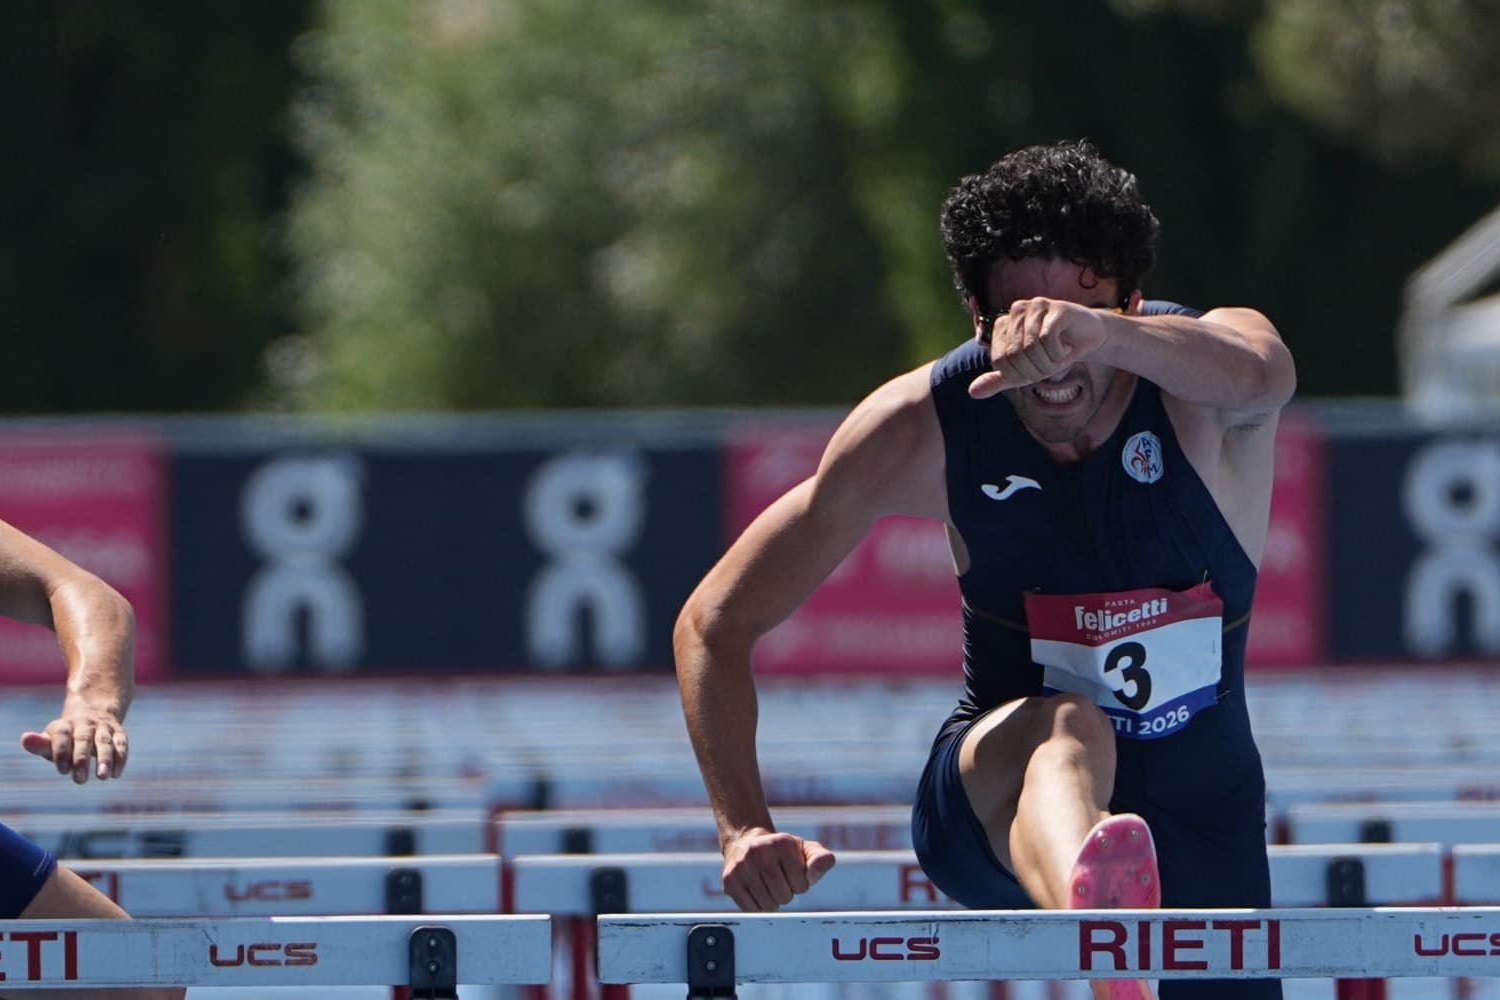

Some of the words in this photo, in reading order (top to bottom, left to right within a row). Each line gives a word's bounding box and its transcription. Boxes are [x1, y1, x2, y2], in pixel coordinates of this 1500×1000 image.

[1074, 598, 1168, 631] felicetti
[1105, 599, 1135, 607] PASTA
[1104, 642, 1152, 710] 3
[1138, 705, 1190, 735] 2026
[223, 880, 313, 901] UCS
[209, 942, 318, 967] UCS
[832, 937, 940, 961] UCS
[1080, 920, 1281, 970] RIETI
